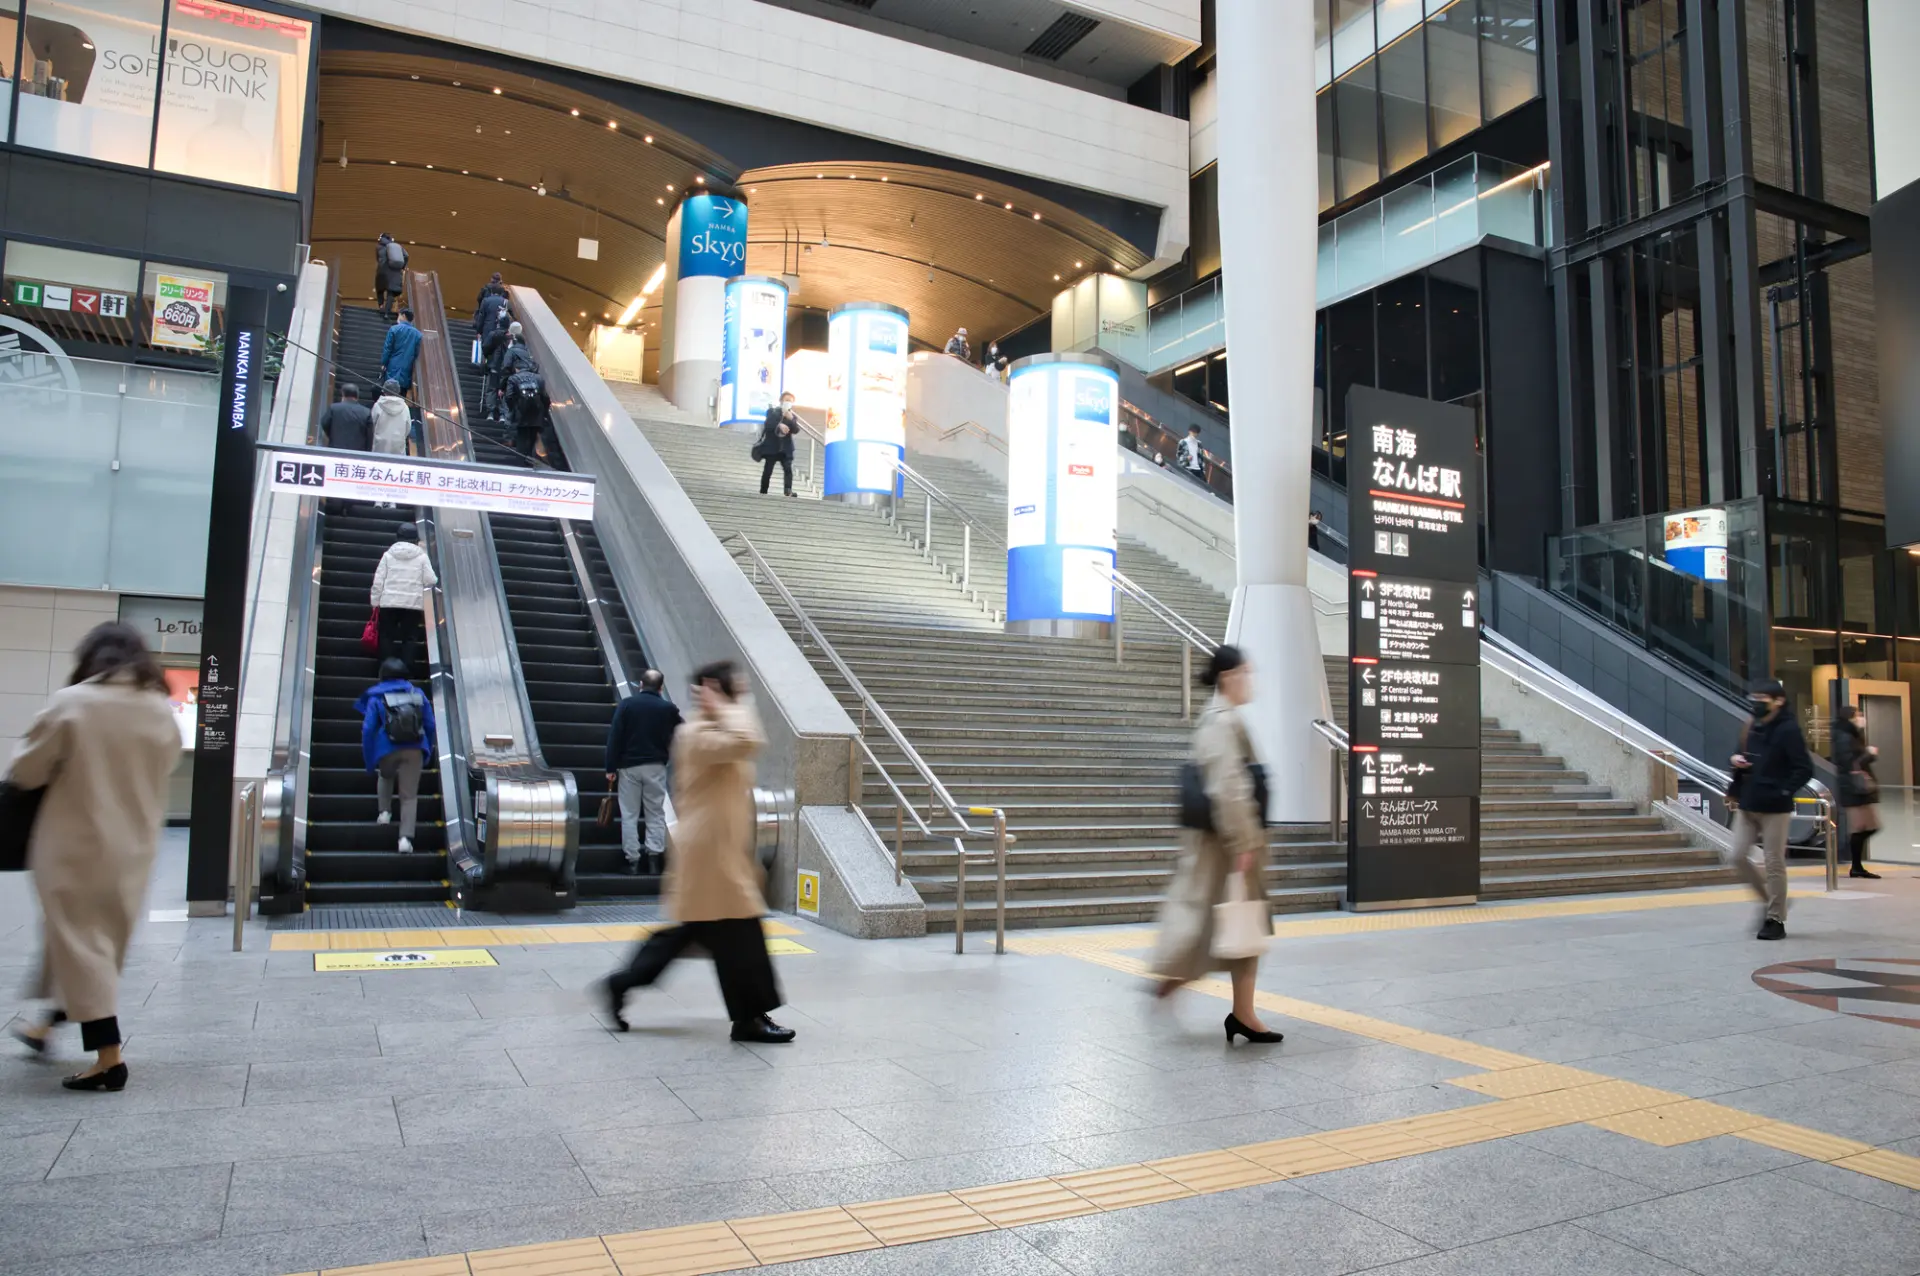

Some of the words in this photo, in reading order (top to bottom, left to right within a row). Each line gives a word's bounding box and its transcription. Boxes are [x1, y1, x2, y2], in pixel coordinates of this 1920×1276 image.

[102, 50, 180, 82] SOFT
[182, 65, 267, 101] DRINK
[17, 283, 125, 317] ローマ軒
[161, 285, 204, 299] フリードリンク
[174, 303, 190, 314] 30分
[165, 308, 196, 328] 660円
[234, 331, 252, 379] NANKAI
[231, 383, 247, 430] NAMBA
[1372, 424, 1417, 459] 南海
[333, 462, 431, 486] 南海なんば駅
[508, 483, 590, 500] チケットカウンター
[1372, 457, 1462, 499] なんば駅
[1373, 500, 1408, 515] NANKAI
[1410, 505, 1442, 520] NAMBA
[1379, 583, 1431, 600] 3F北改札口
[1388, 599, 1404, 608] North
[1405, 601, 1418, 609] Gate
[1380, 669, 1439, 686] 2F中央改札口
[1389, 686, 1409, 694] Central
[1410, 687, 1423, 695] Gate
[1380, 763, 1434, 776] エレベーター
[1380, 800, 1439, 813] なんばパークス
[1380, 813, 1430, 826] なんばCITY
[1380, 828, 1402, 837] NAMBA
[1403, 828, 1421, 836] PARKS
[1422, 827, 1444, 835] NAMBA
[1444, 826, 1457, 835] CITY
